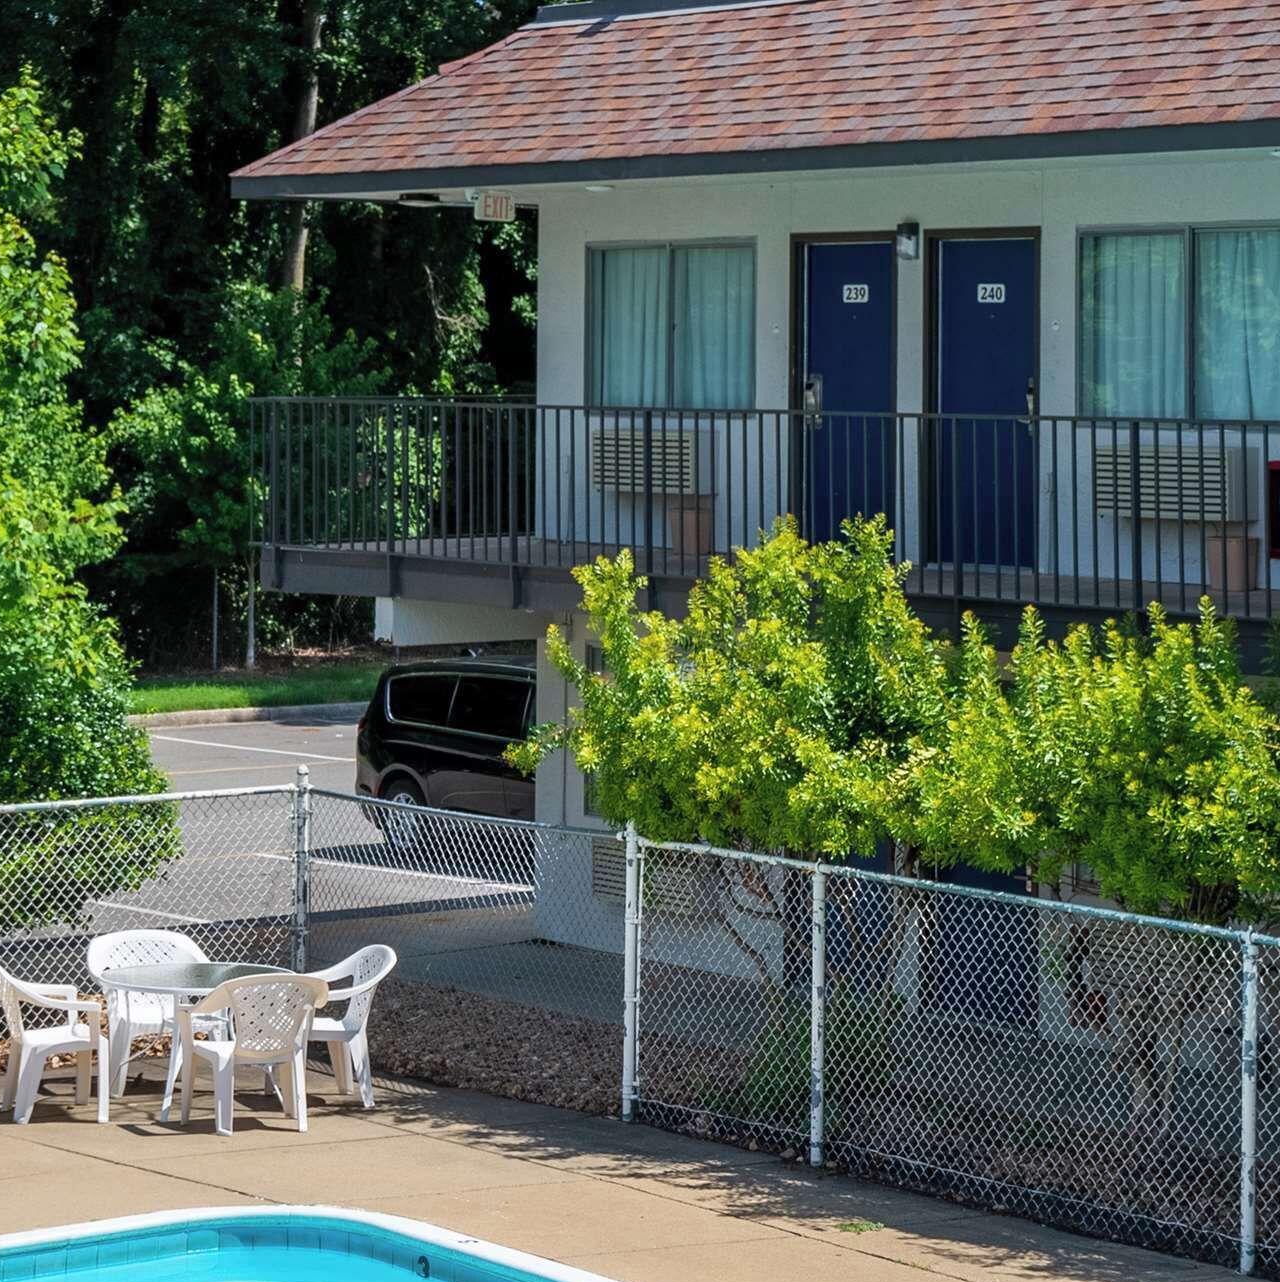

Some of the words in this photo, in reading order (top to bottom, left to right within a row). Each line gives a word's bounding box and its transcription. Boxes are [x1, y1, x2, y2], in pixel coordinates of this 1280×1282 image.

[483, 193, 511, 219] EXIT
[846, 287, 866, 301] 239
[980, 286, 1003, 301] 240
[416, 1256, 430, 1278] 3
